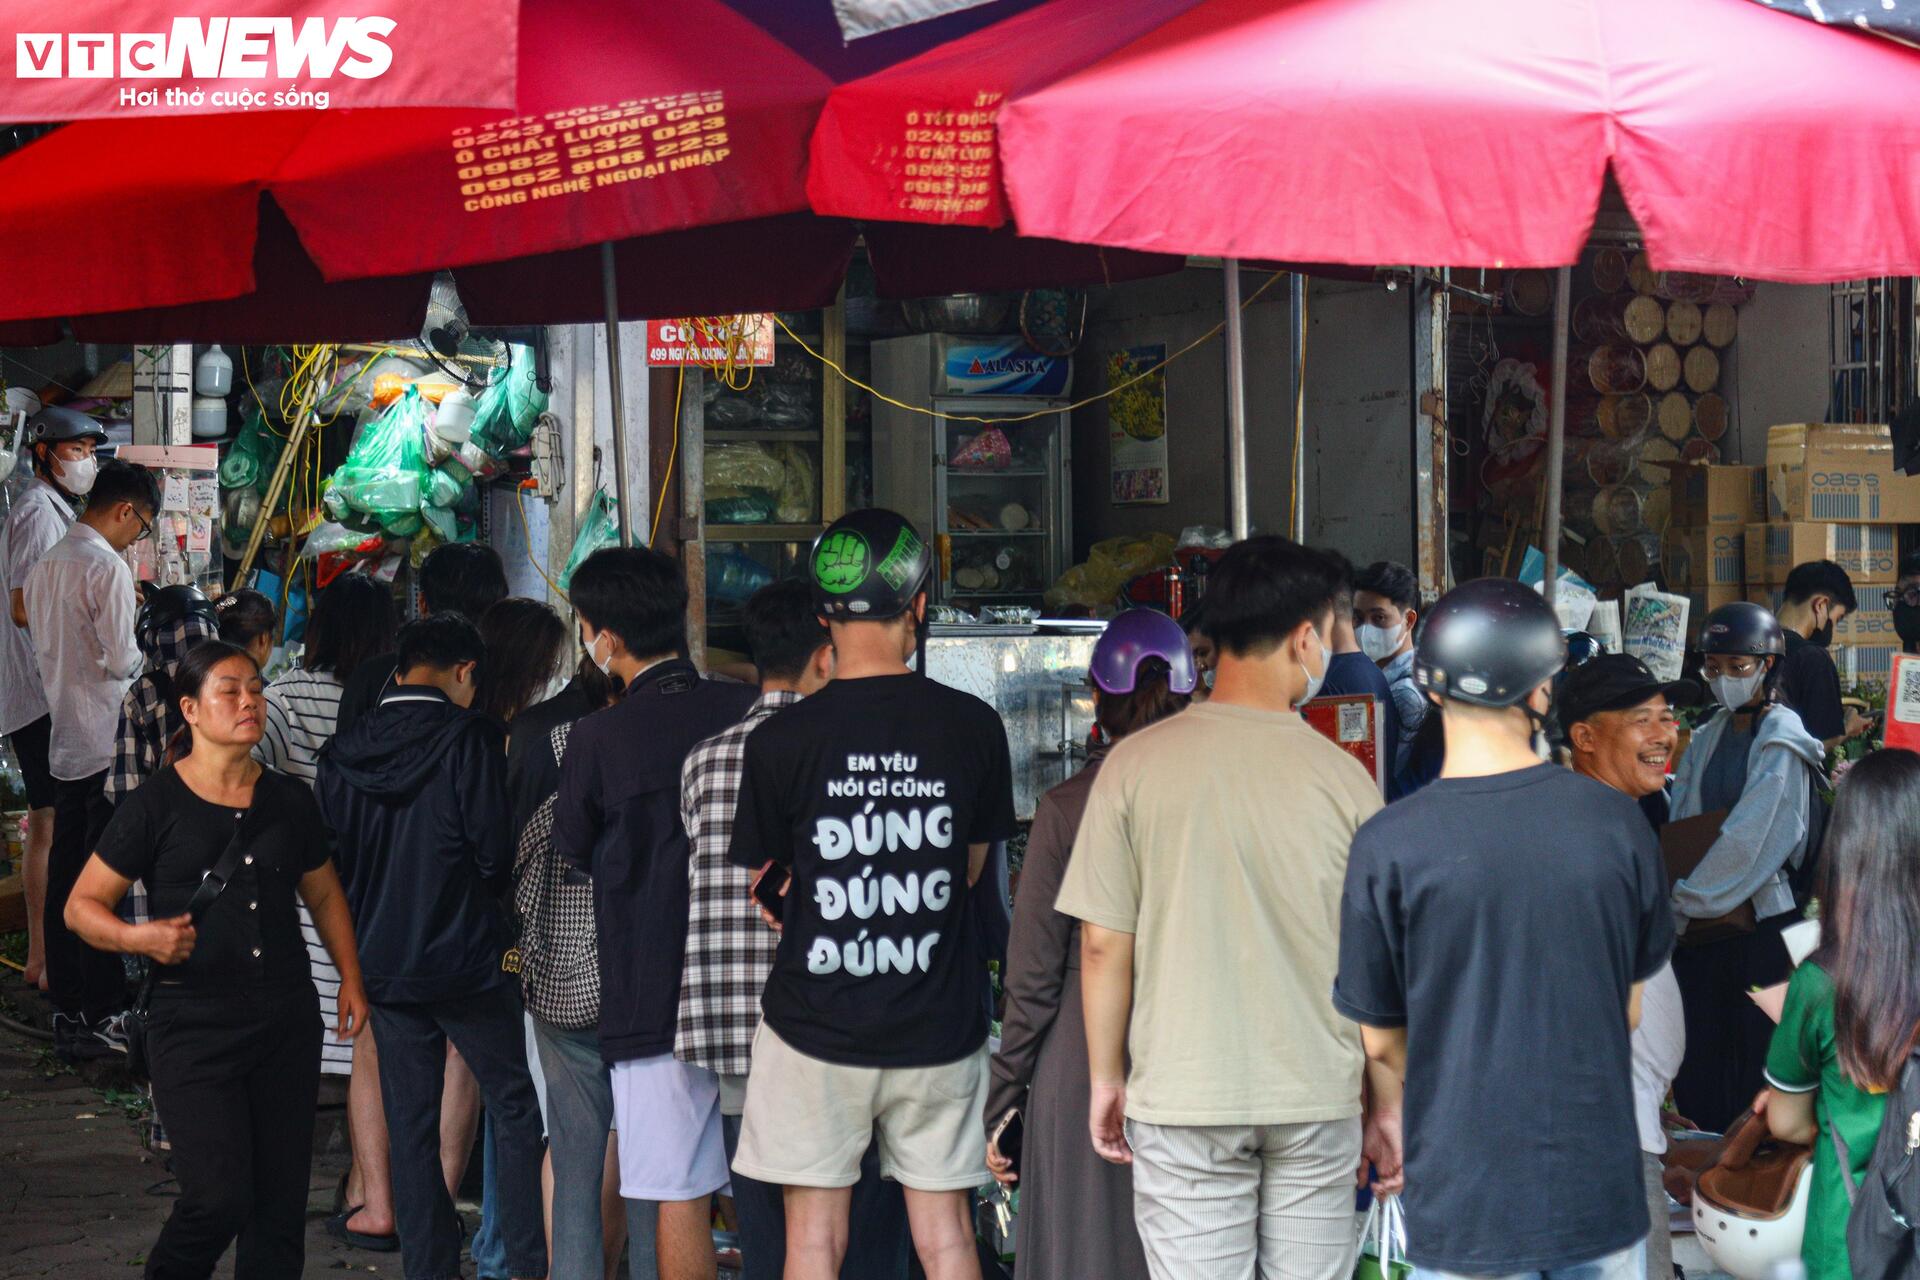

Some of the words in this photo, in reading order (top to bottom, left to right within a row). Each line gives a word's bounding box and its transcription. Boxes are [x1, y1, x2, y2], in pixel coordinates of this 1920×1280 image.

[665, 102, 725, 121] CAO
[457, 151, 559, 180] 0982
[568, 133, 643, 158] 532
[652, 115, 726, 141] 023
[460, 166, 562, 196] 0962
[570, 149, 646, 175] 808
[655, 132, 729, 158] 223
[463, 191, 528, 212] CÔNG
[595, 161, 666, 187] NGOẠI
[650, 347, 668, 361] 499
[984, 358, 1048, 374] ALASKA
[847, 755, 876, 772] EM
[880, 752, 918, 773] YÊU
[827, 777, 864, 798] NÓI
[867, 777, 888, 797] GÌ
[890, 778, 946, 798] CŨNG
[811, 800, 953, 861] ĐÚNG
[813, 864, 952, 921] ĐÚNG
